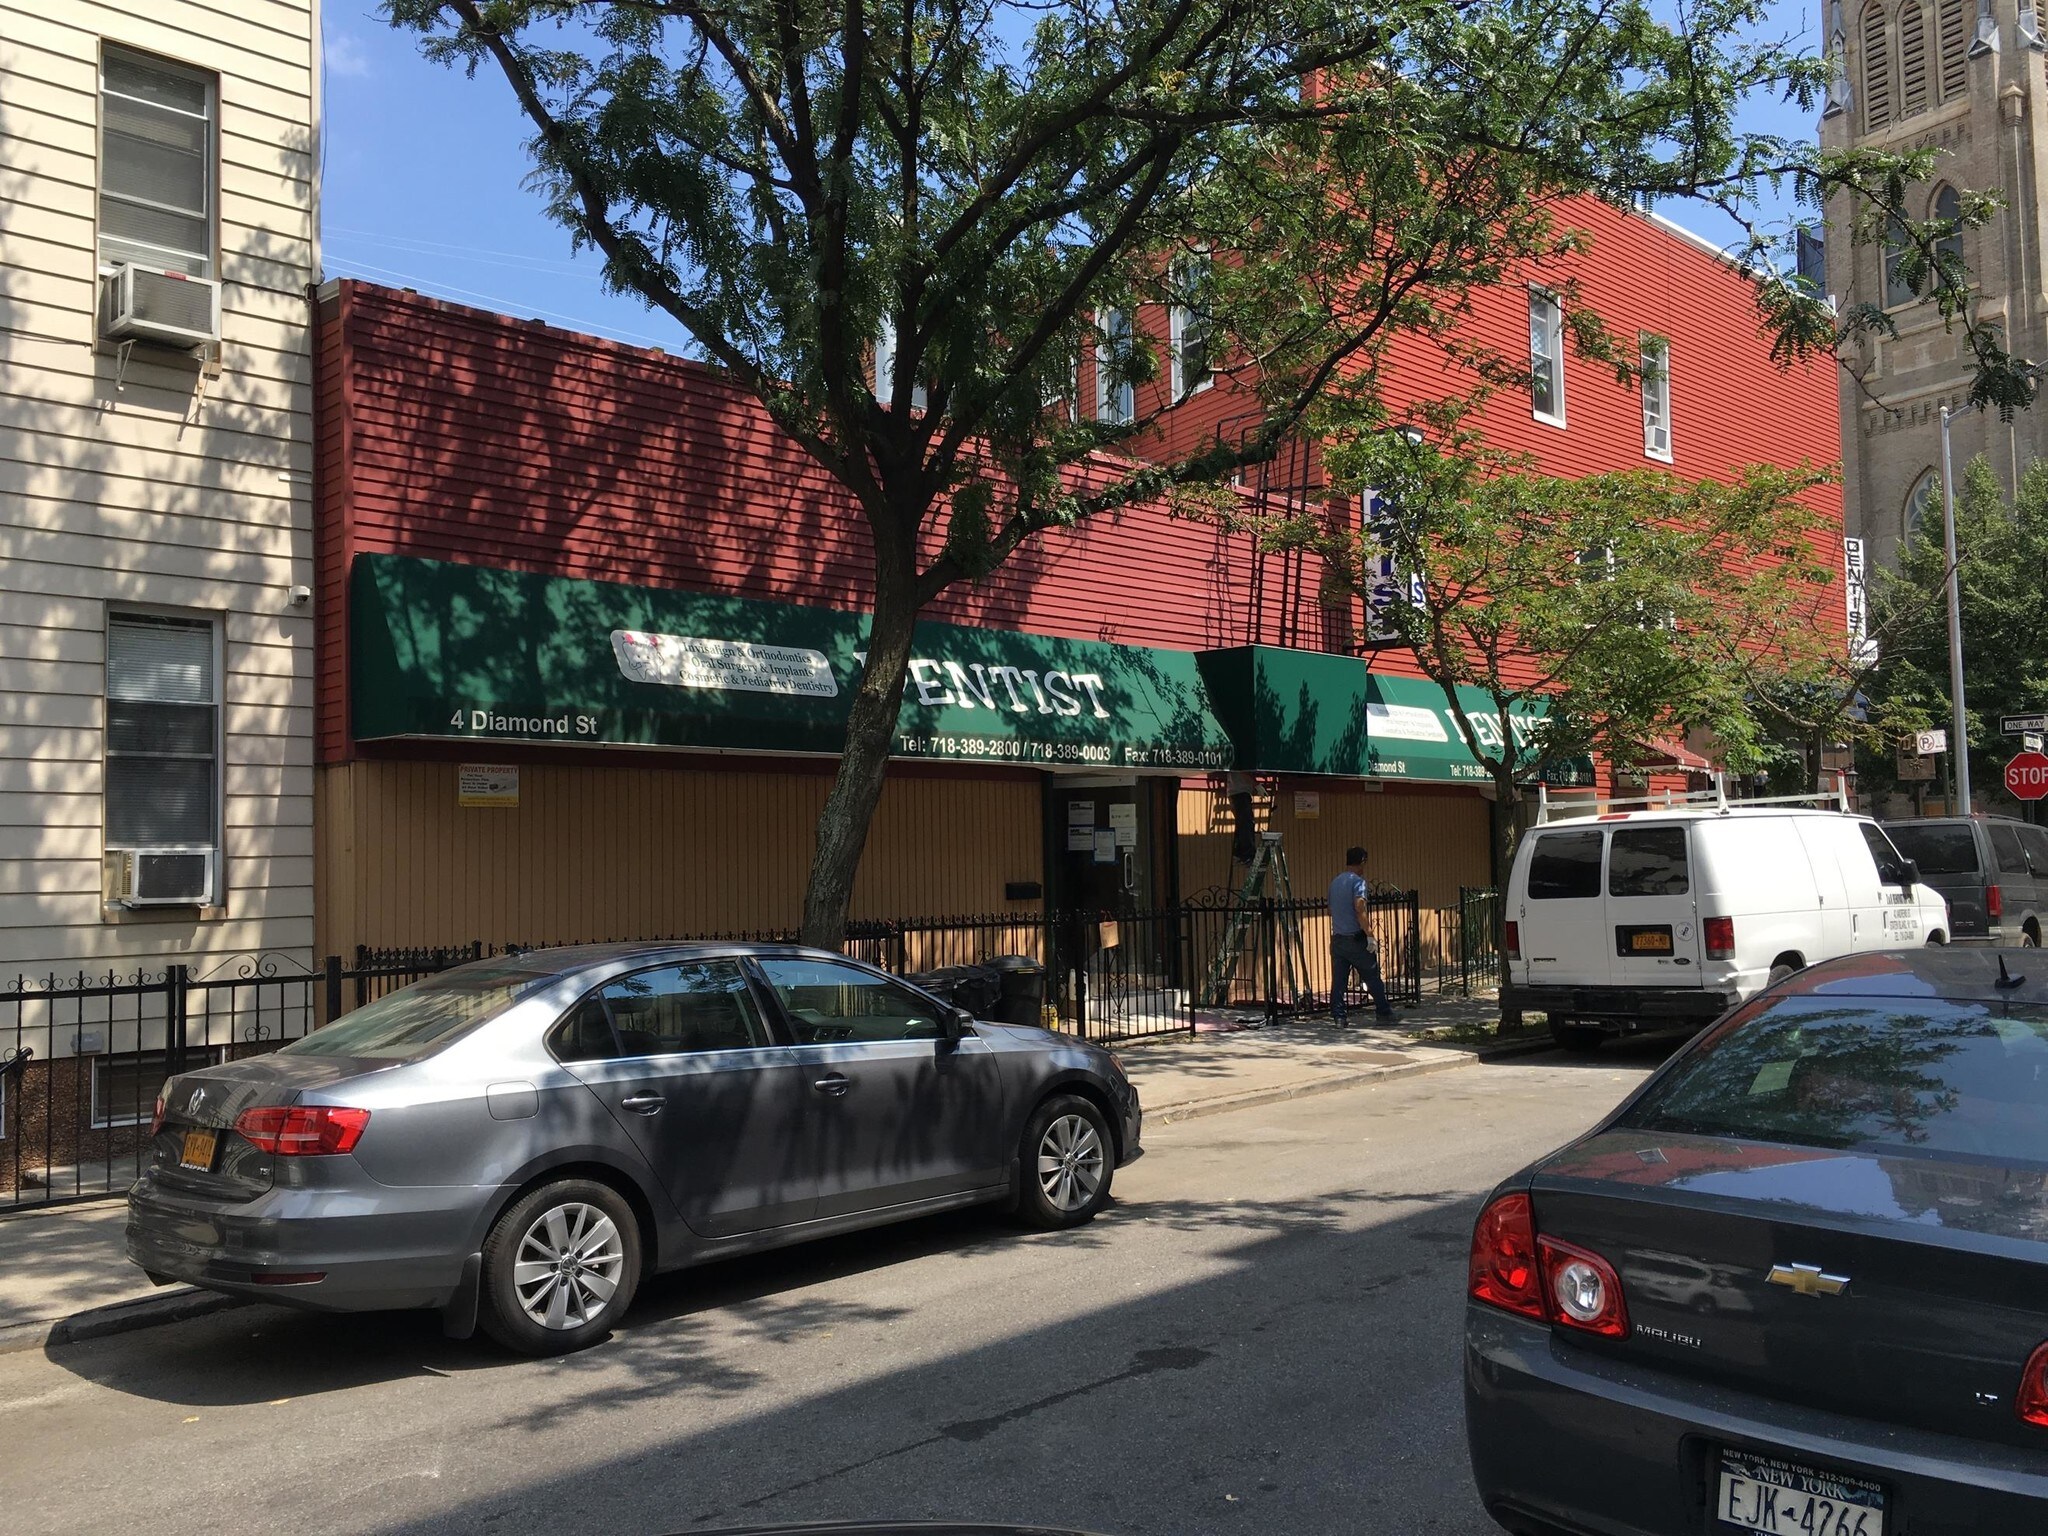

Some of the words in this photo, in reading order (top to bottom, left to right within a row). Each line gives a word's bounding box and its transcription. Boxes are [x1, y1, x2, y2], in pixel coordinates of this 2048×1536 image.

[1846, 540, 1860, 639] DENTIST
[683, 641, 736, 658] Invisalign
[738, 647, 747, 658] &
[747, 648, 812, 664] Orthodontics
[691, 657, 715, 670] Oral
[716, 659, 758, 675] Surgery
[760, 664, 768, 674] &
[769, 664, 815, 678] Implants
[679, 669, 730, 685] Cosmetic
[731, 675, 741, 685] &
[741, 674, 788, 689] Pediatric
[789, 679, 834, 695] Dentistry
[853, 651, 1110, 718] ENTIST
[450, 709, 464, 729] 4
[471, 710, 569, 734] Diamond
[576, 715, 598, 735] St
[2006, 721, 2024, 730] ONE
[2027, 720, 2045, 729] WAY
[900, 735, 926, 753] Tel:
[930, 737, 1020, 756] 718-389-2800
[1030, 742, 1111, 761] 718-389-0003
[1124, 747, 1149, 762] Fax:
[1152, 749, 1222, 765] 718-389-0101
[460, 765, 486, 774] PRIVATE
[487, 766, 518, 775] PROPERTY
[1397, 761, 1406, 774] St
[1462, 765, 1494, 778] 718-389-2
[1636, 1324, 1702, 1349] MALIBU
[1722, 1449, 1742, 1460] NEW
[1743, 1453, 1768, 1467] YORK,
[1770, 1459, 1790, 1471] NEW
[1791, 1463, 1815, 1477] YORK
[1757, 1465, 1795, 1488] NEW
[1801, 1475, 1845, 1500] YORK
